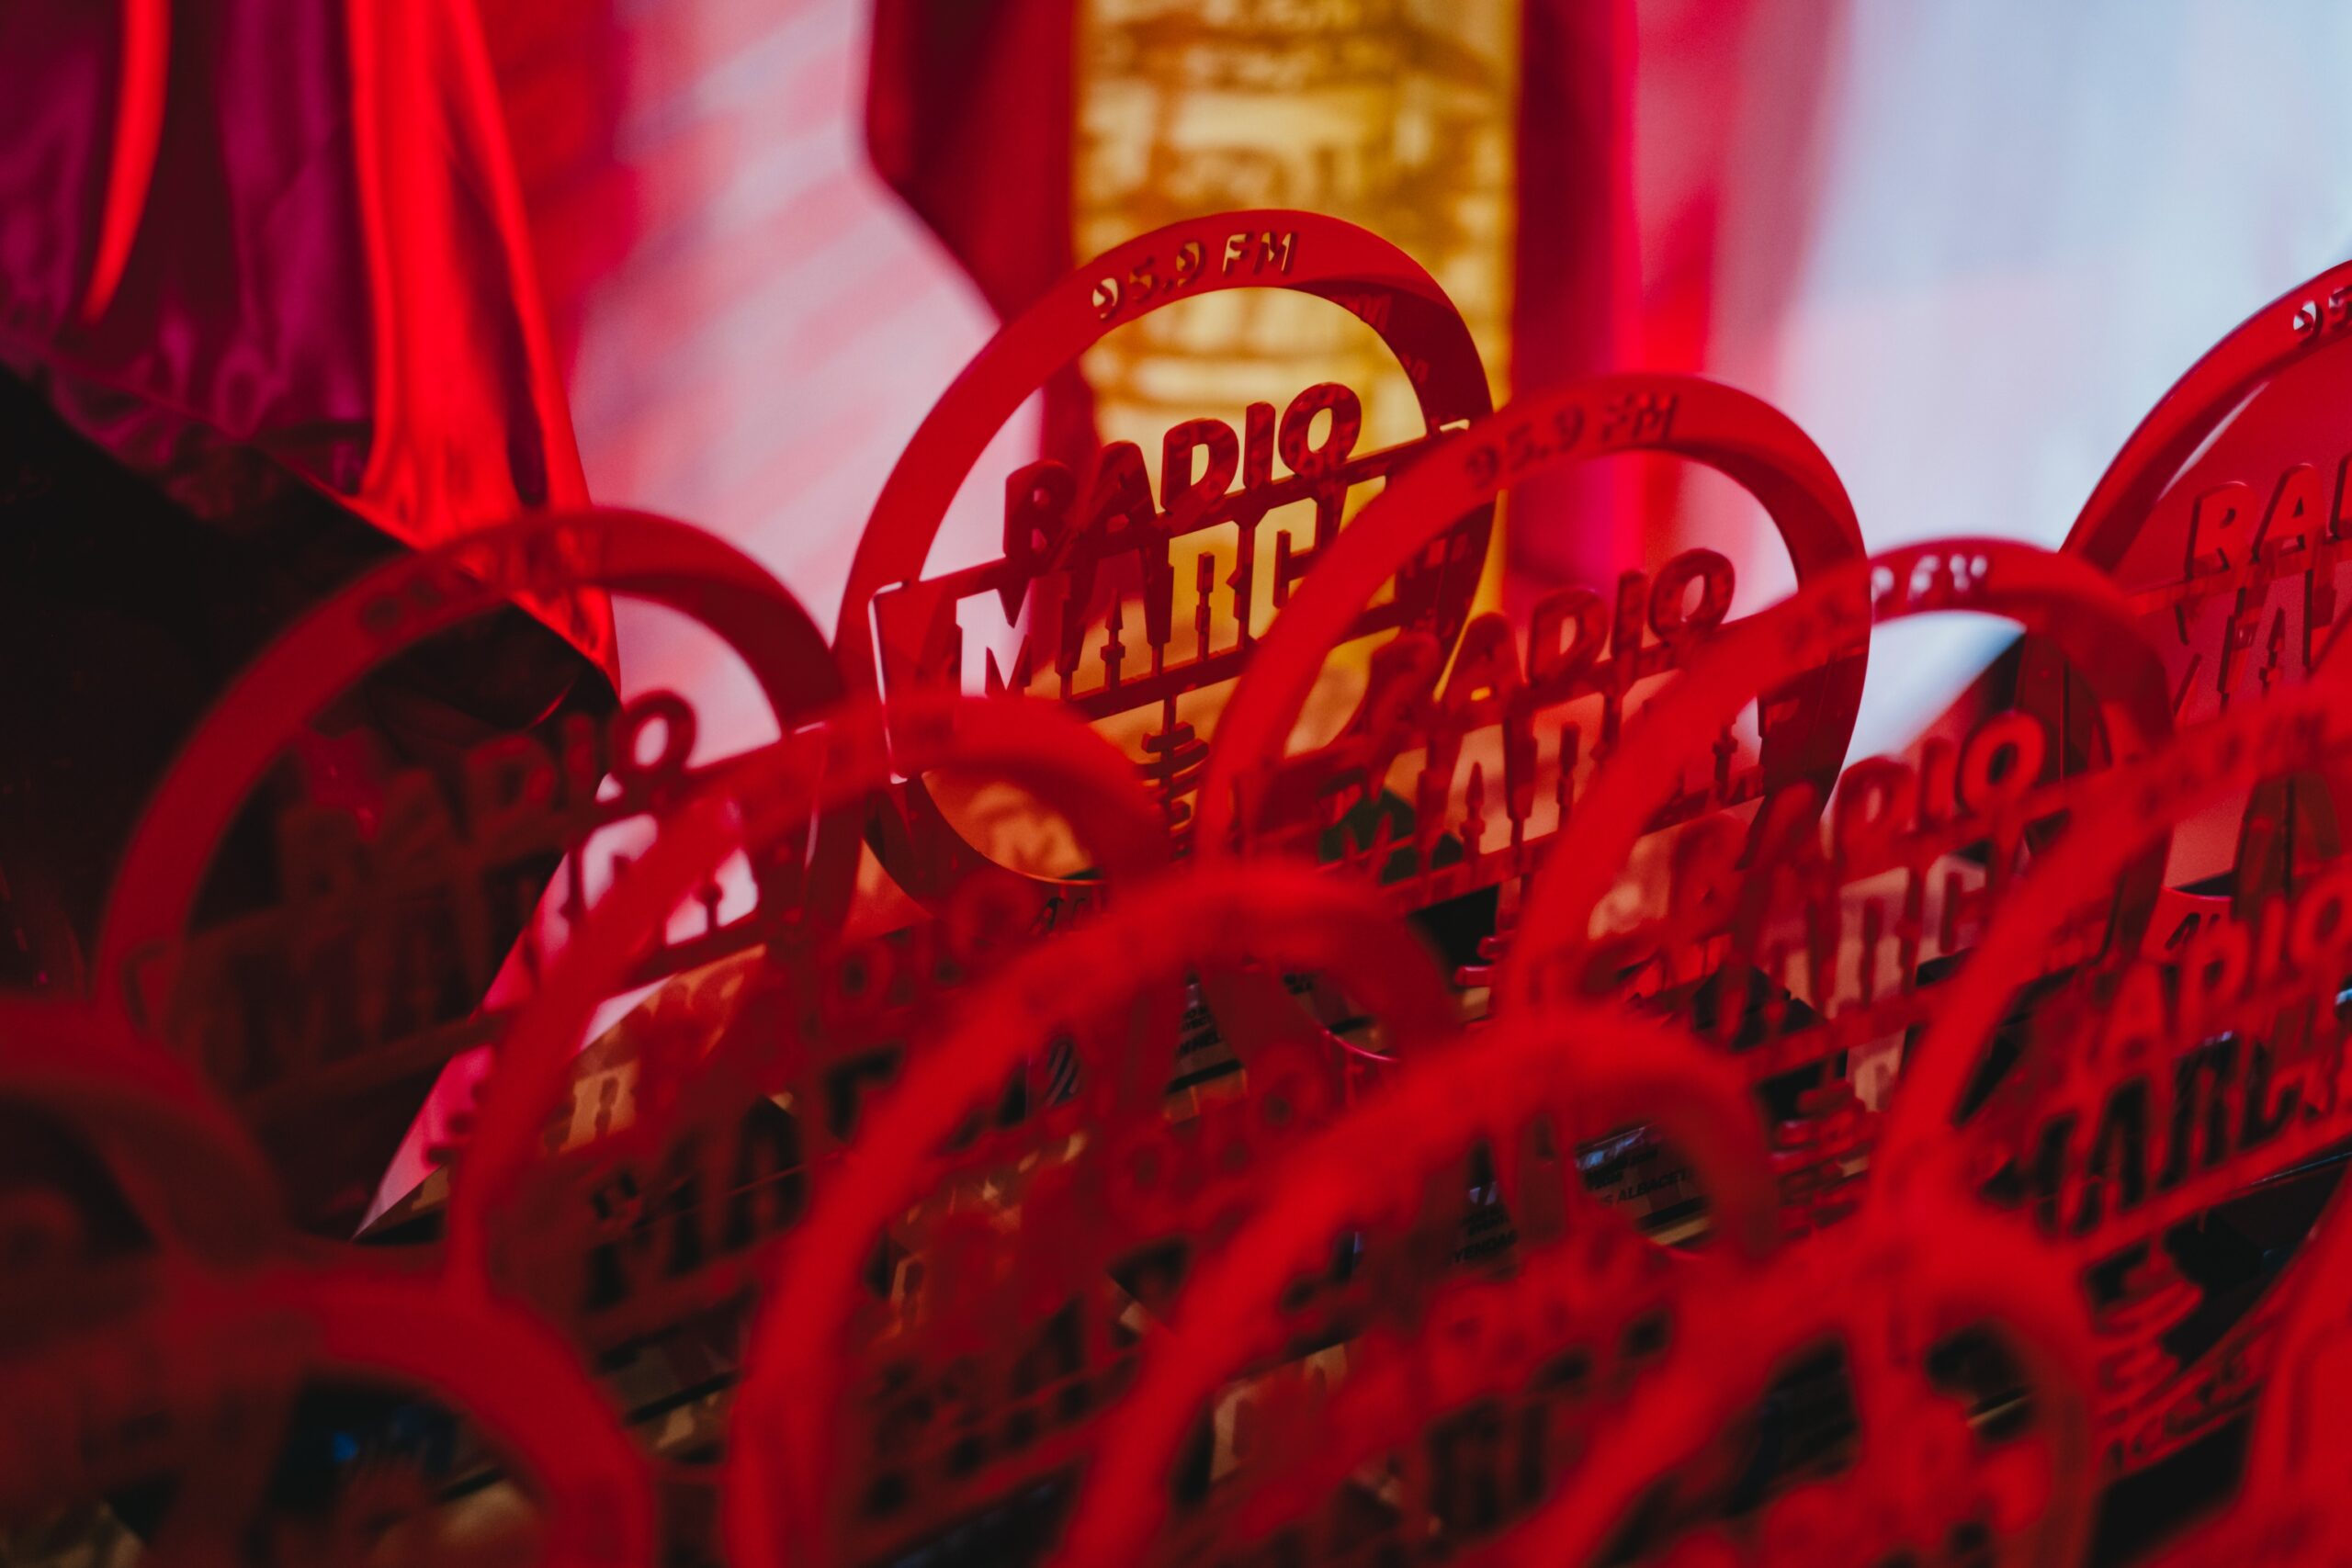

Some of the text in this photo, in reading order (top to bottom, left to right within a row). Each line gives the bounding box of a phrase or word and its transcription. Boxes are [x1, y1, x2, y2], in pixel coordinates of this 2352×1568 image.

[1091, 231, 1298, 322] 95.9 FM
[1002, 382, 1362, 560] RADIO
[1599, 391, 1679, 443] FM
[956, 478, 1392, 698] MARC
[2185, 453, 2352, 581] RA
[1360, 547, 1736, 733] RADIO
